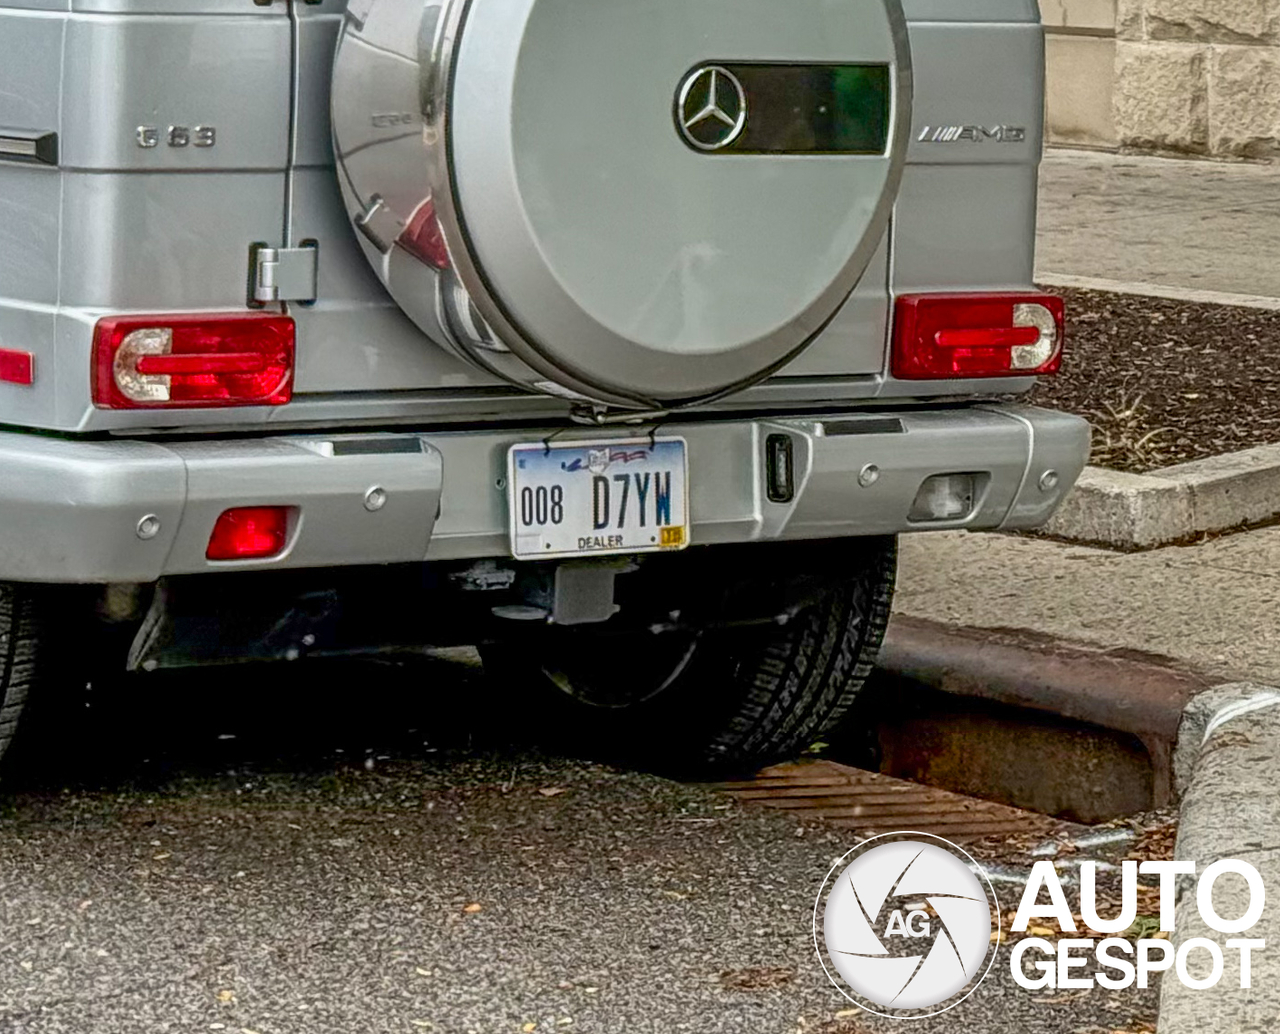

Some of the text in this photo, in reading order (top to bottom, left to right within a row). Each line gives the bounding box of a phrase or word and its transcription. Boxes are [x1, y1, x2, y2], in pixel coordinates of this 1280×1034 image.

[521, 471, 671, 530] 008 D7YW
[577, 535, 624, 549] DEALER
